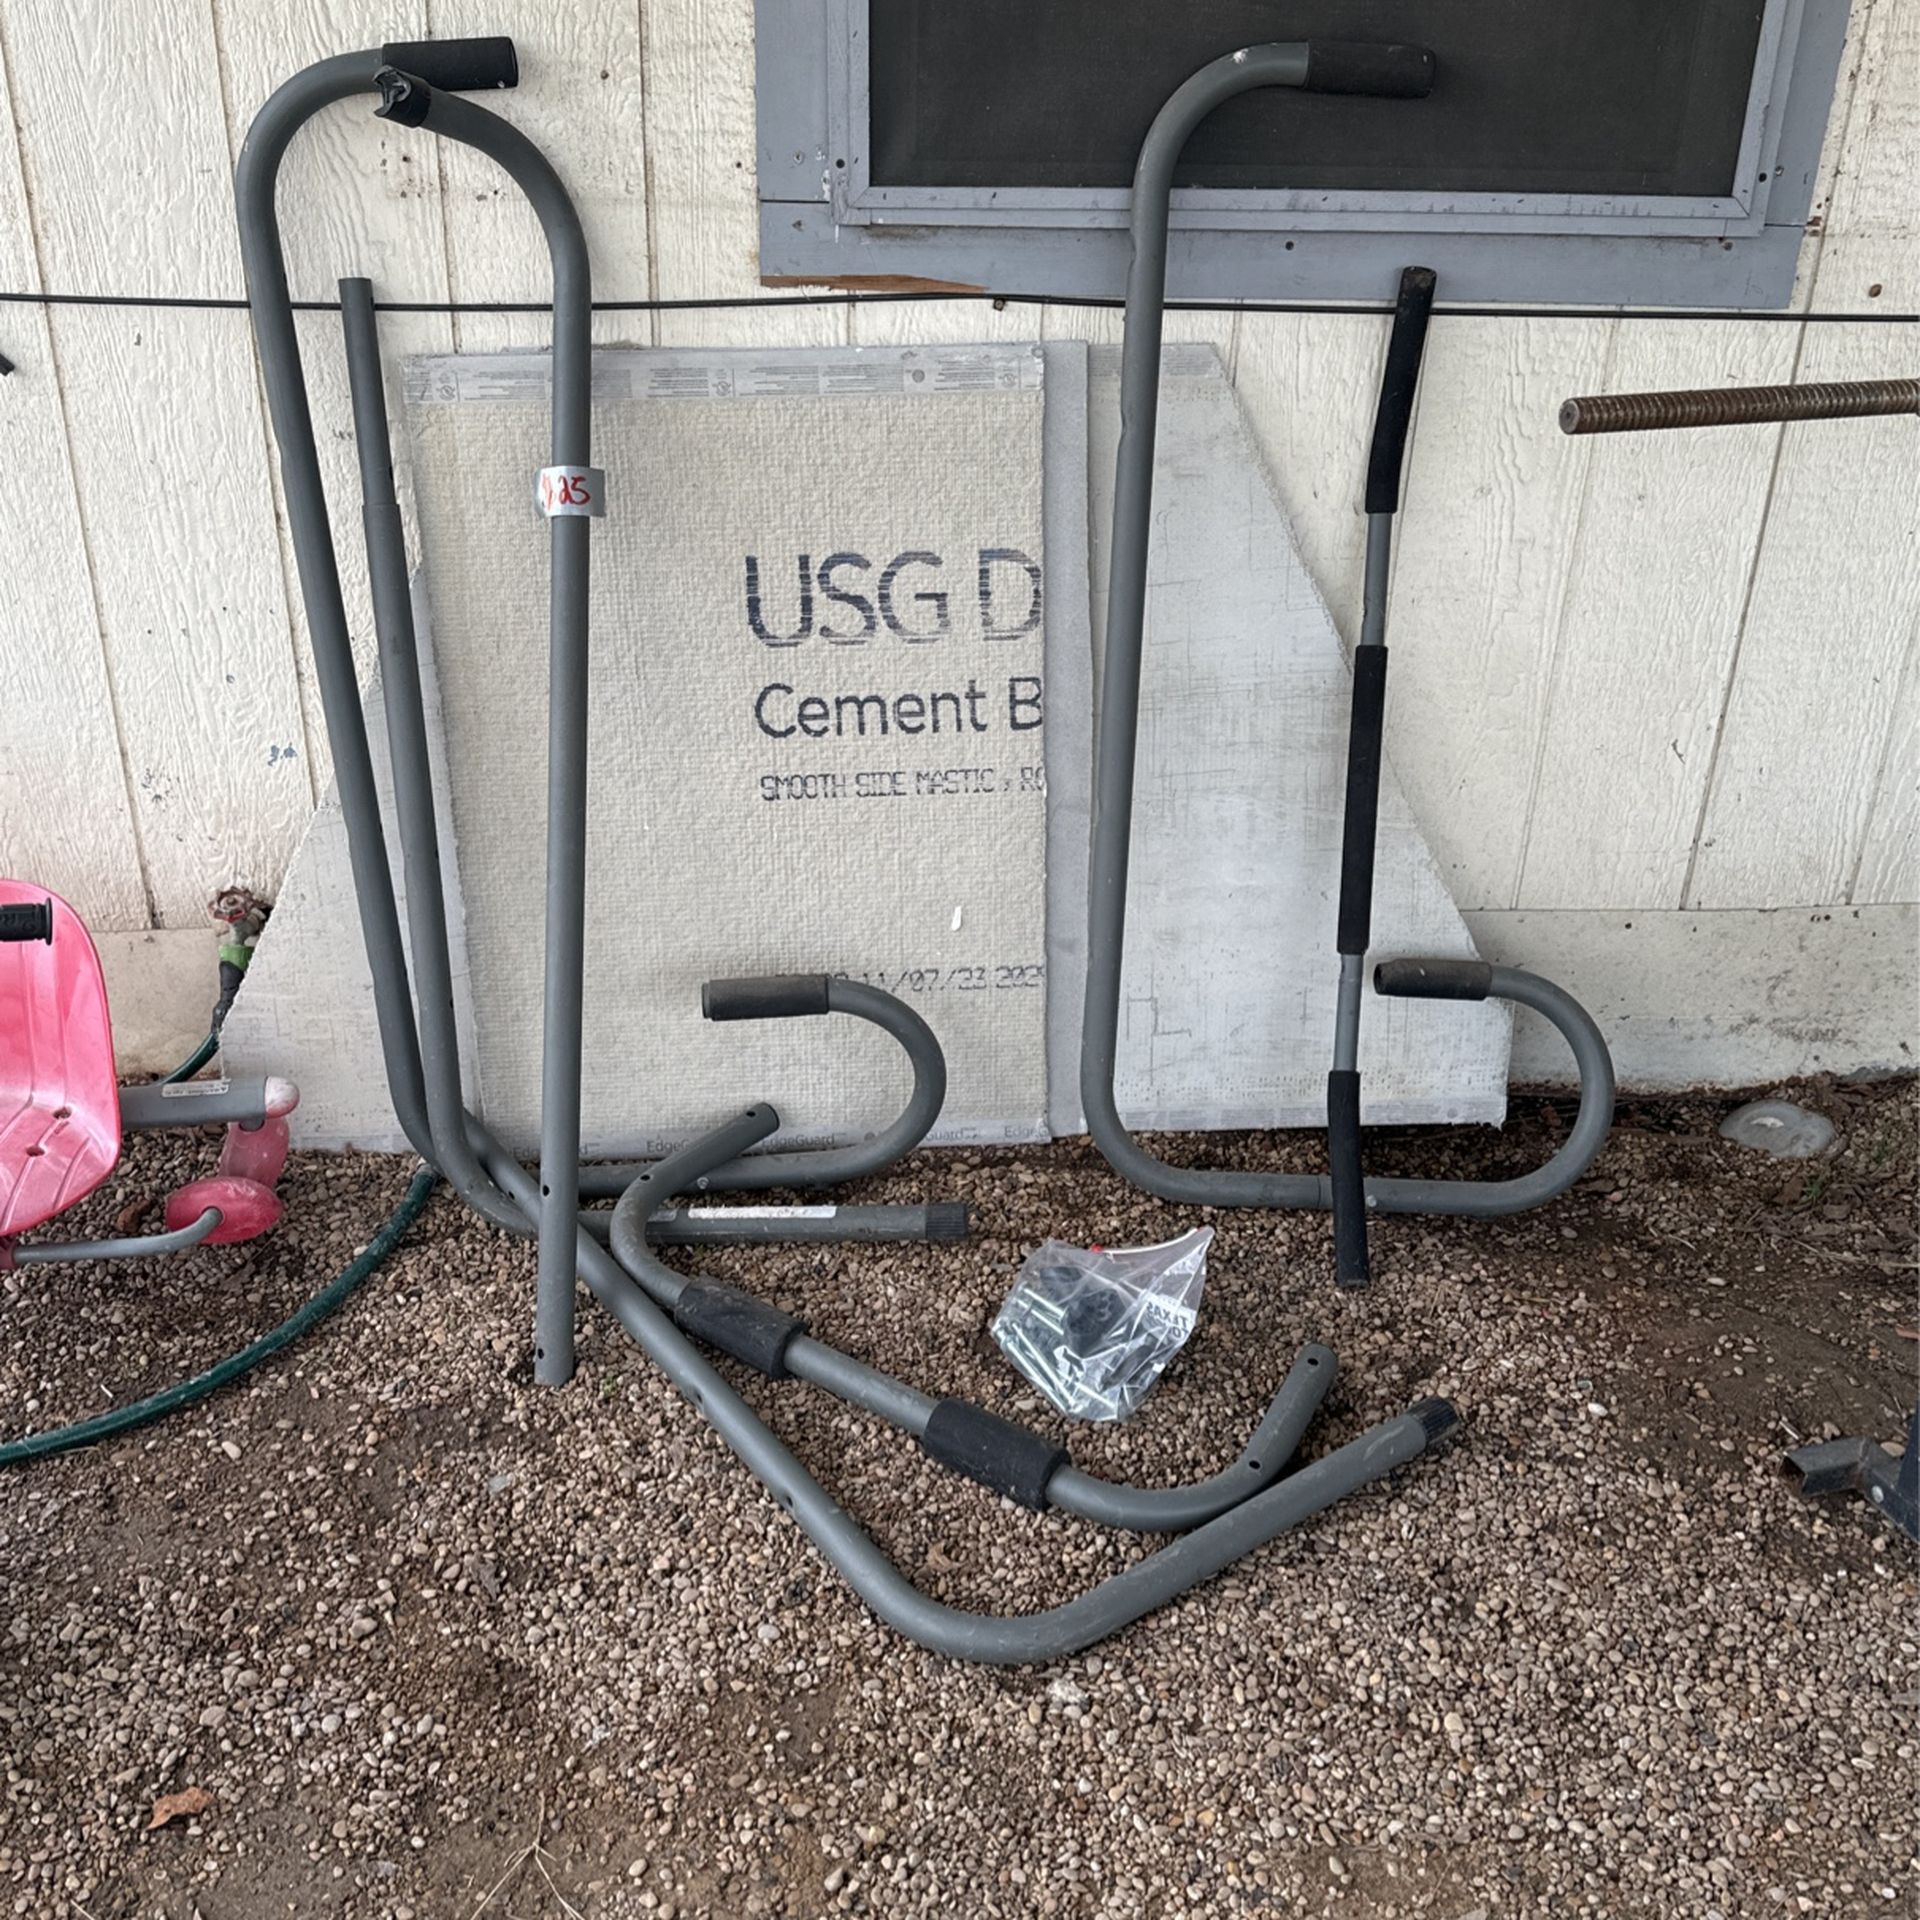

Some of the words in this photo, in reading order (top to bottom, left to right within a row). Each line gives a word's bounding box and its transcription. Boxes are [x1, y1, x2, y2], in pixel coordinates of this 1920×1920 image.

[746, 551, 949, 648] USG
[979, 547, 1042, 642] D
[754, 679, 988, 739] Cement
[1008, 676, 1043, 731] B
[760, 773, 847, 801] SMOOTH
[855, 771, 907, 798] SIDE
